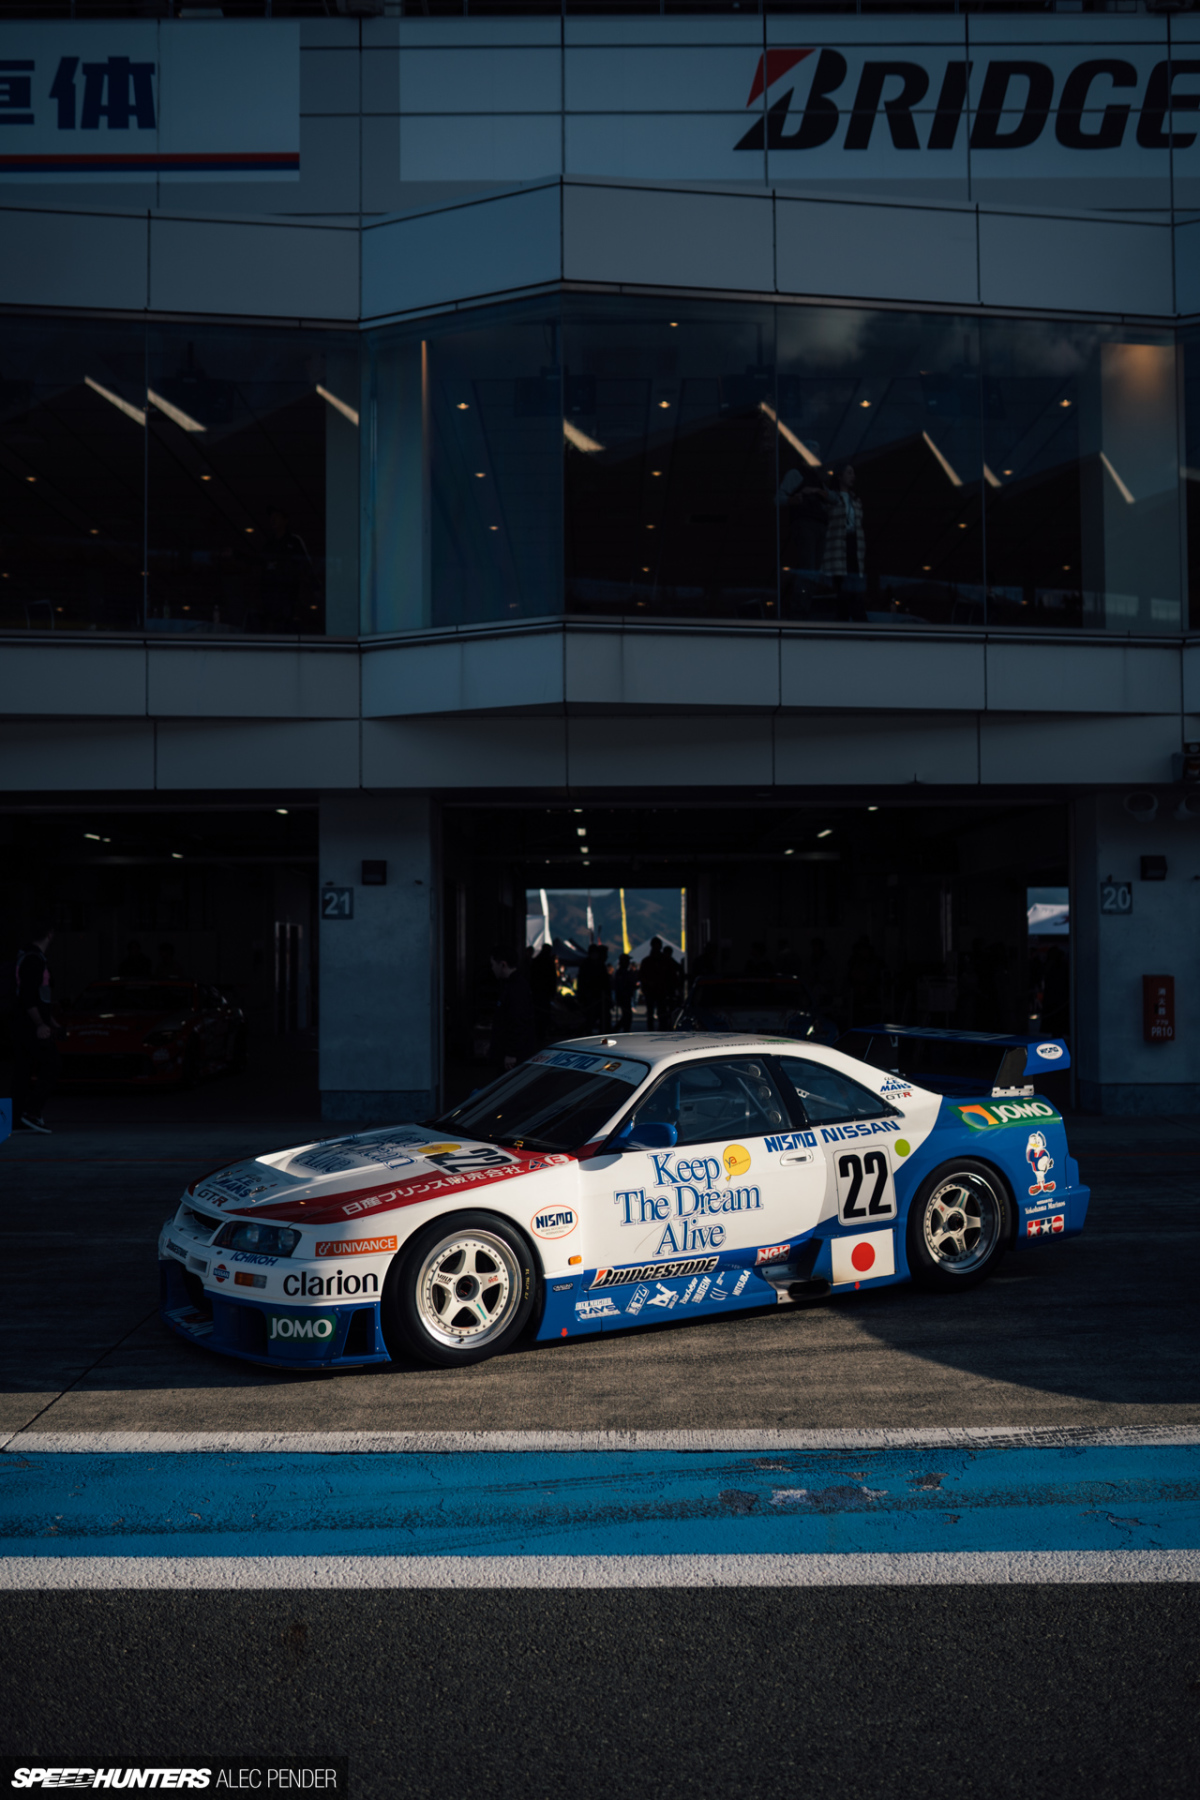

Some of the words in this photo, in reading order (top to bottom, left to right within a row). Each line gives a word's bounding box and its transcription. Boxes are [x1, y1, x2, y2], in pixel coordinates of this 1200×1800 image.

[733, 48, 1200, 151] BRIDGE
[324, 891, 350, 915] 21
[1103, 886, 1131, 909] 20
[880, 1083, 912, 1092] MANS
[990, 1102, 1053, 1123] JOMO
[764, 1131, 818, 1153] NISMO
[820, 1120, 901, 1144] NISSAN
[649, 1152, 721, 1189] Keep
[341, 1165, 525, 1215] 日産プリンス販売会社
[838, 1151, 892, 1219] 22
[615, 1188, 671, 1225] The
[674, 1184, 763, 1218] Dream
[535, 1211, 573, 1229] NISMO
[333, 1238, 395, 1253] UNIVANCE
[655, 1218, 725, 1255] Alive
[231, 1251, 279, 1266] ICHIKOH
[760, 1246, 789, 1260] NGK
[283, 1270, 378, 1297] Clarion
[592, 1257, 718, 1289] BRIDGESTONE
[732, 1270, 751, 1296] MITSUBA
[270, 1317, 333, 1339] JOMO
